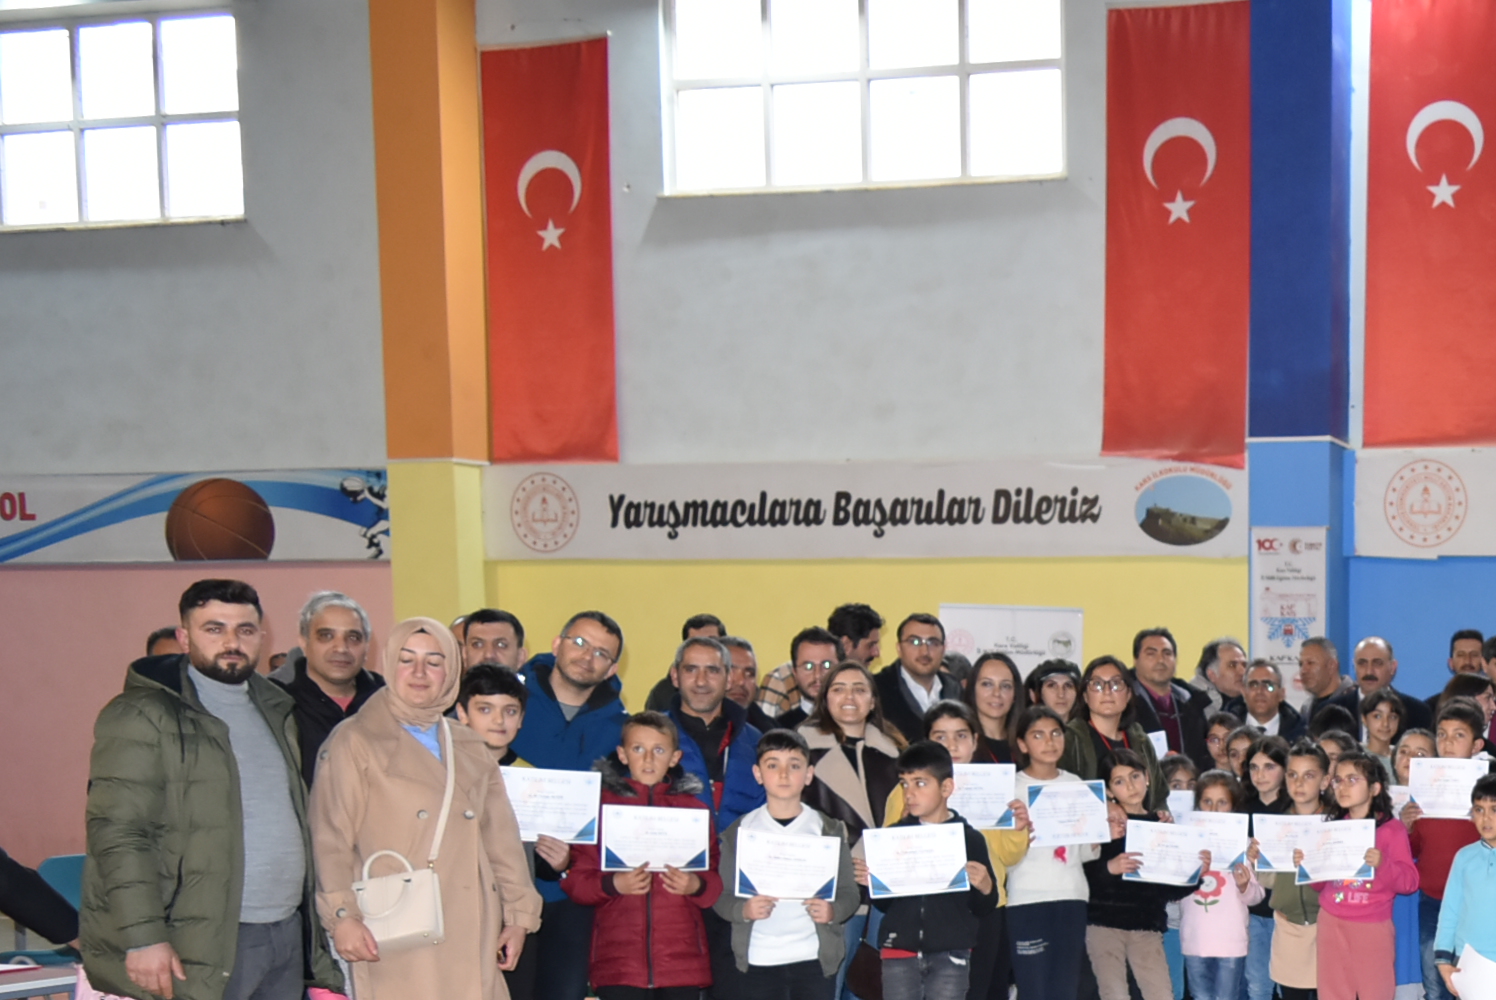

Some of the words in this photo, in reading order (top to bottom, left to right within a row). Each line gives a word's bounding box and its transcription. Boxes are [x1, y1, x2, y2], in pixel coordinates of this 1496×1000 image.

[608, 490, 827, 540] Yarışmacılara
[832, 488, 986, 539] Başarılar
[991, 485, 1102, 526] Dileriz
[1347, 891, 1370, 904] LIFE
